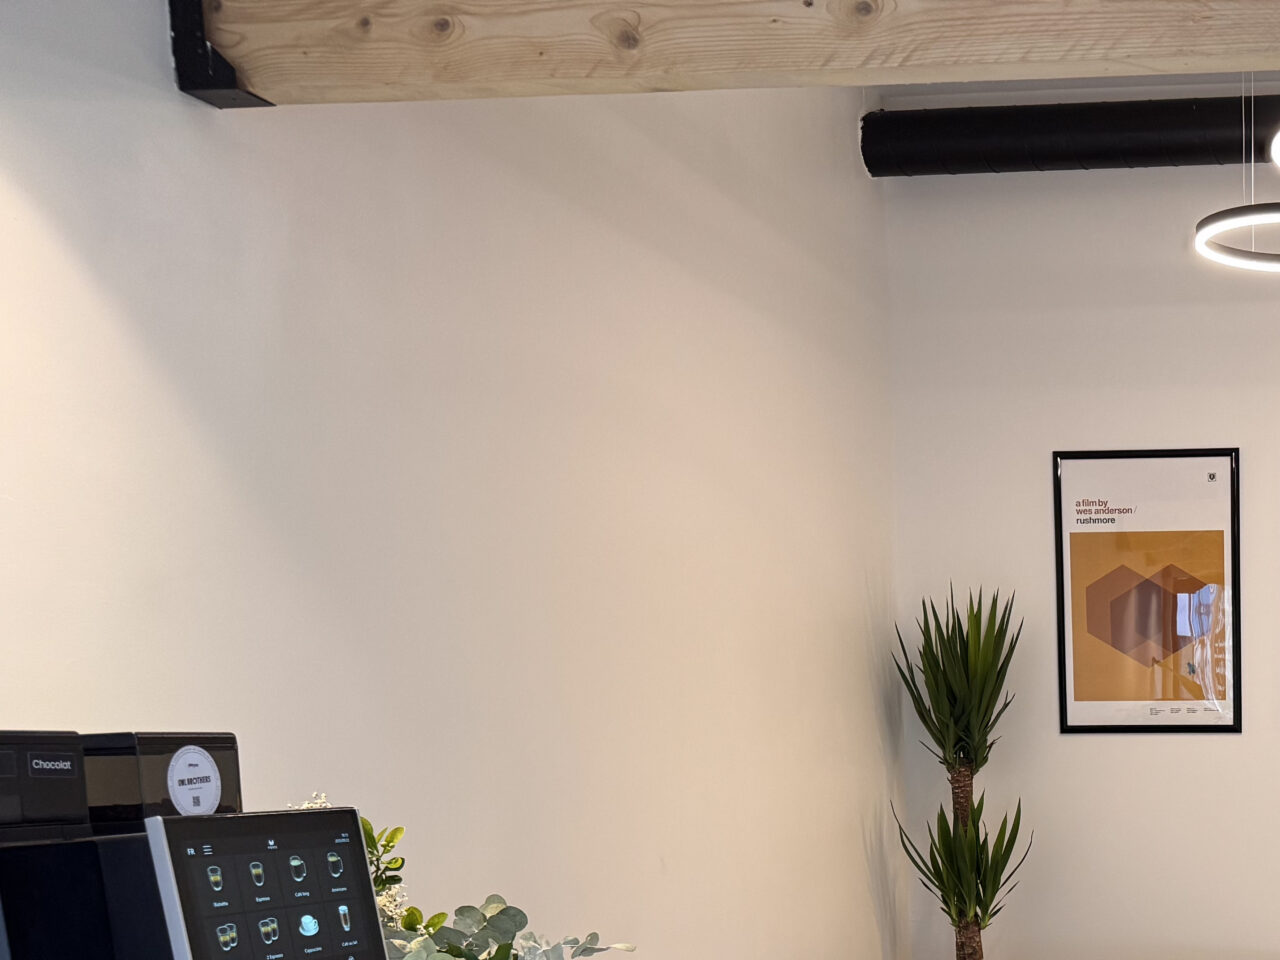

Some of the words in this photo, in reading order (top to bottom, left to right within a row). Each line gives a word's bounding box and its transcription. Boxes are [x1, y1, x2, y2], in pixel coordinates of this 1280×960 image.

[1082, 499, 1097, 507] film
[1098, 499, 1108, 509] by
[1094, 507, 1133, 515] anderson
[1076, 517, 1116, 525] rushmore
[32, 759, 73, 769] Chocolat
[187, 848, 196, 856] FR
